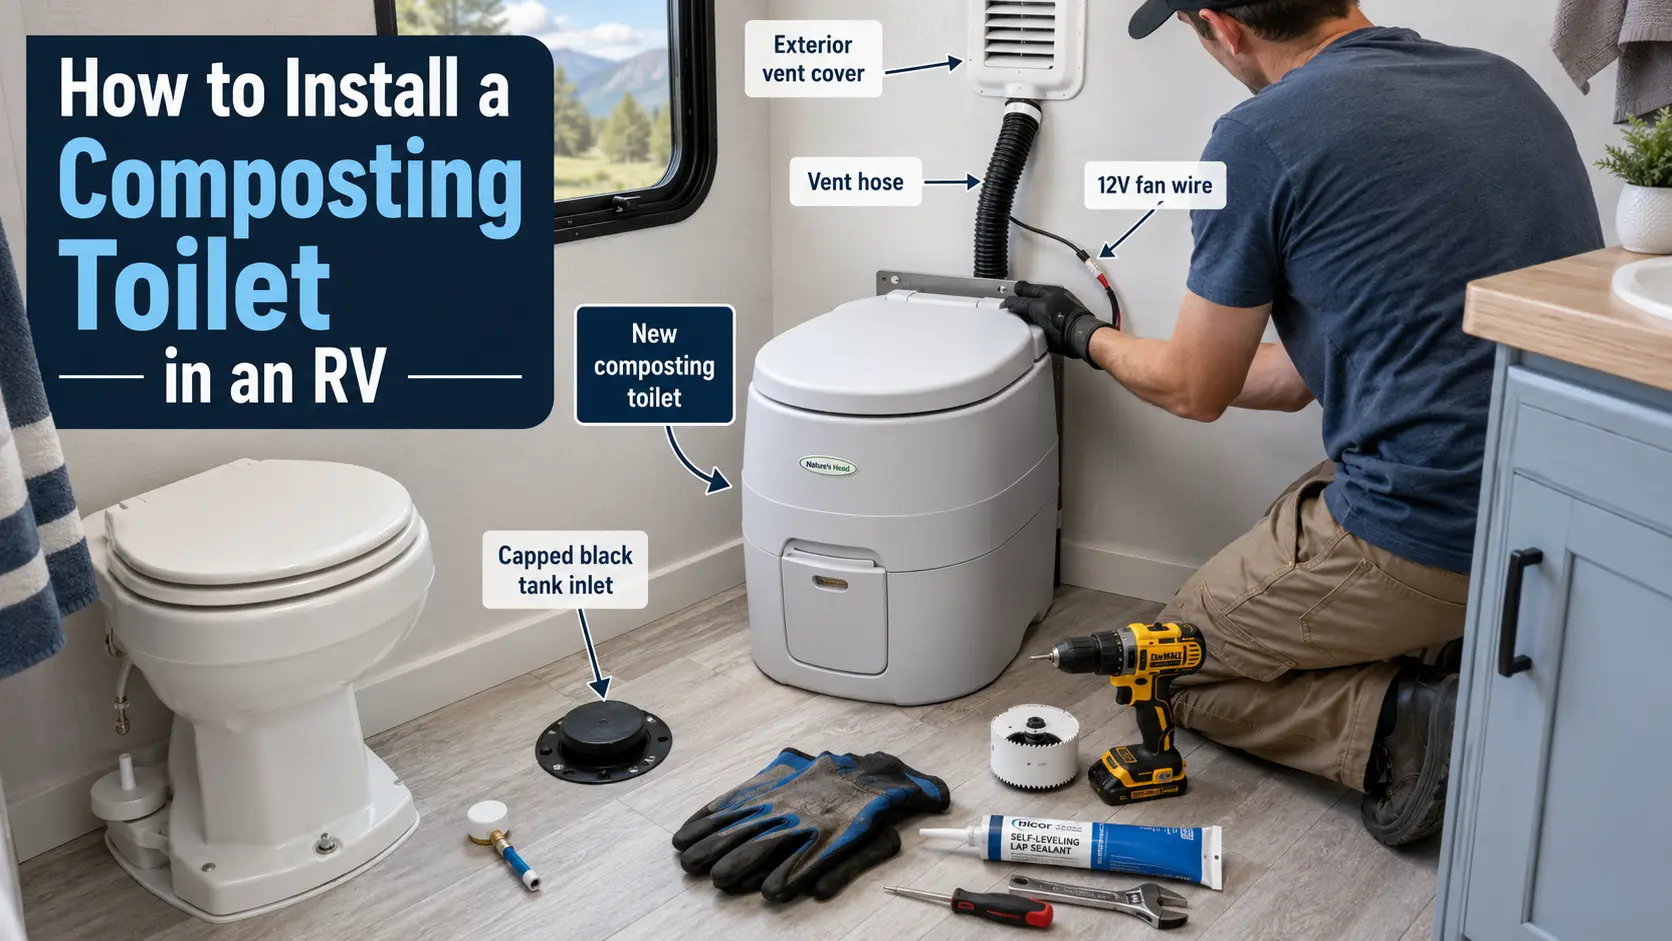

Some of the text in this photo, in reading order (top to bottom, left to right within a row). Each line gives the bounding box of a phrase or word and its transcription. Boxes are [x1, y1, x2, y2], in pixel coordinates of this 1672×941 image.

[806, 460, 832, 470] Nature's
[1011, 832, 1080, 847] SELF-LEVELING
[1011, 842, 1072, 855] LAP SEALANT
